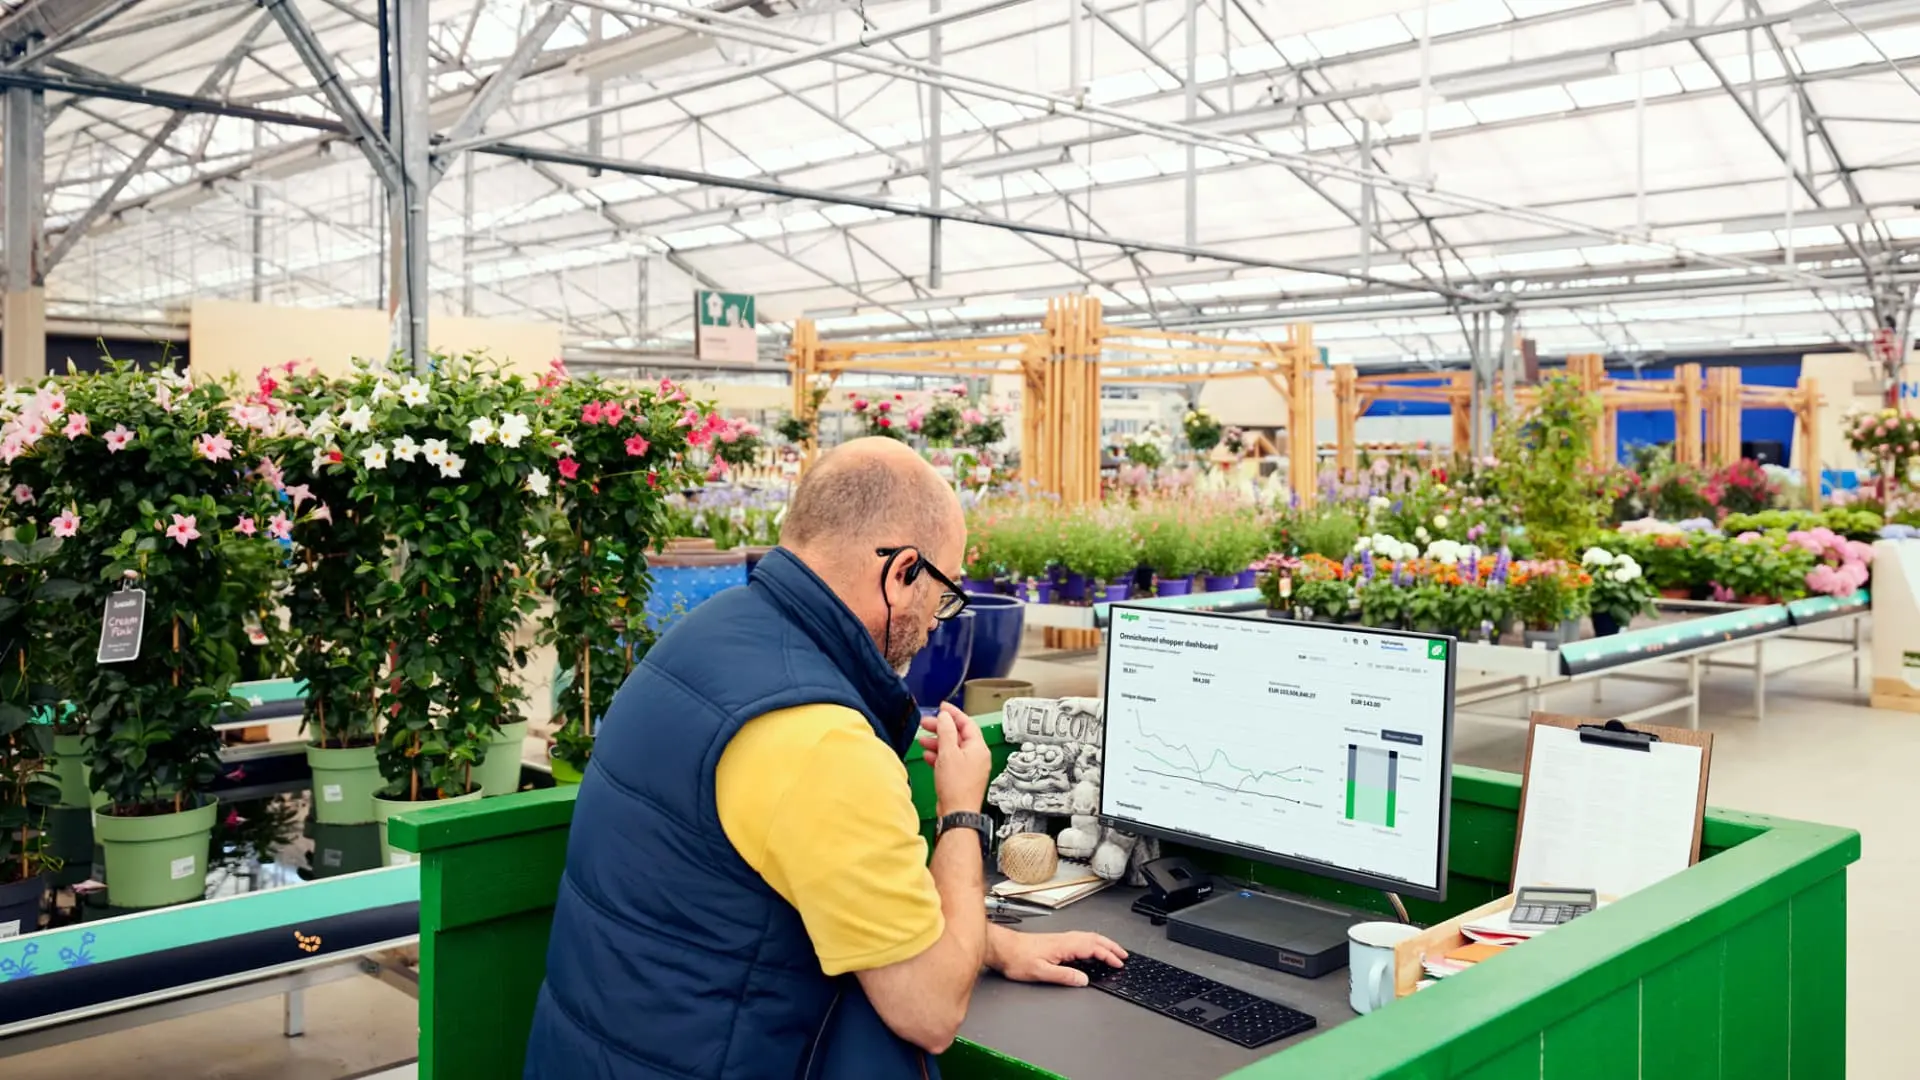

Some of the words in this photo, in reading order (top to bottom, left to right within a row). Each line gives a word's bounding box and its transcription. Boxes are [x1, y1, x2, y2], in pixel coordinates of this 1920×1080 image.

[108, 616, 138, 627] Cream
[1119, 632, 1158, 645] Omnichannel
[1159, 637, 1184, 648] shopper
[1185, 639, 1218, 651] dashboard
[1006, 703, 1101, 743] WELCOM
